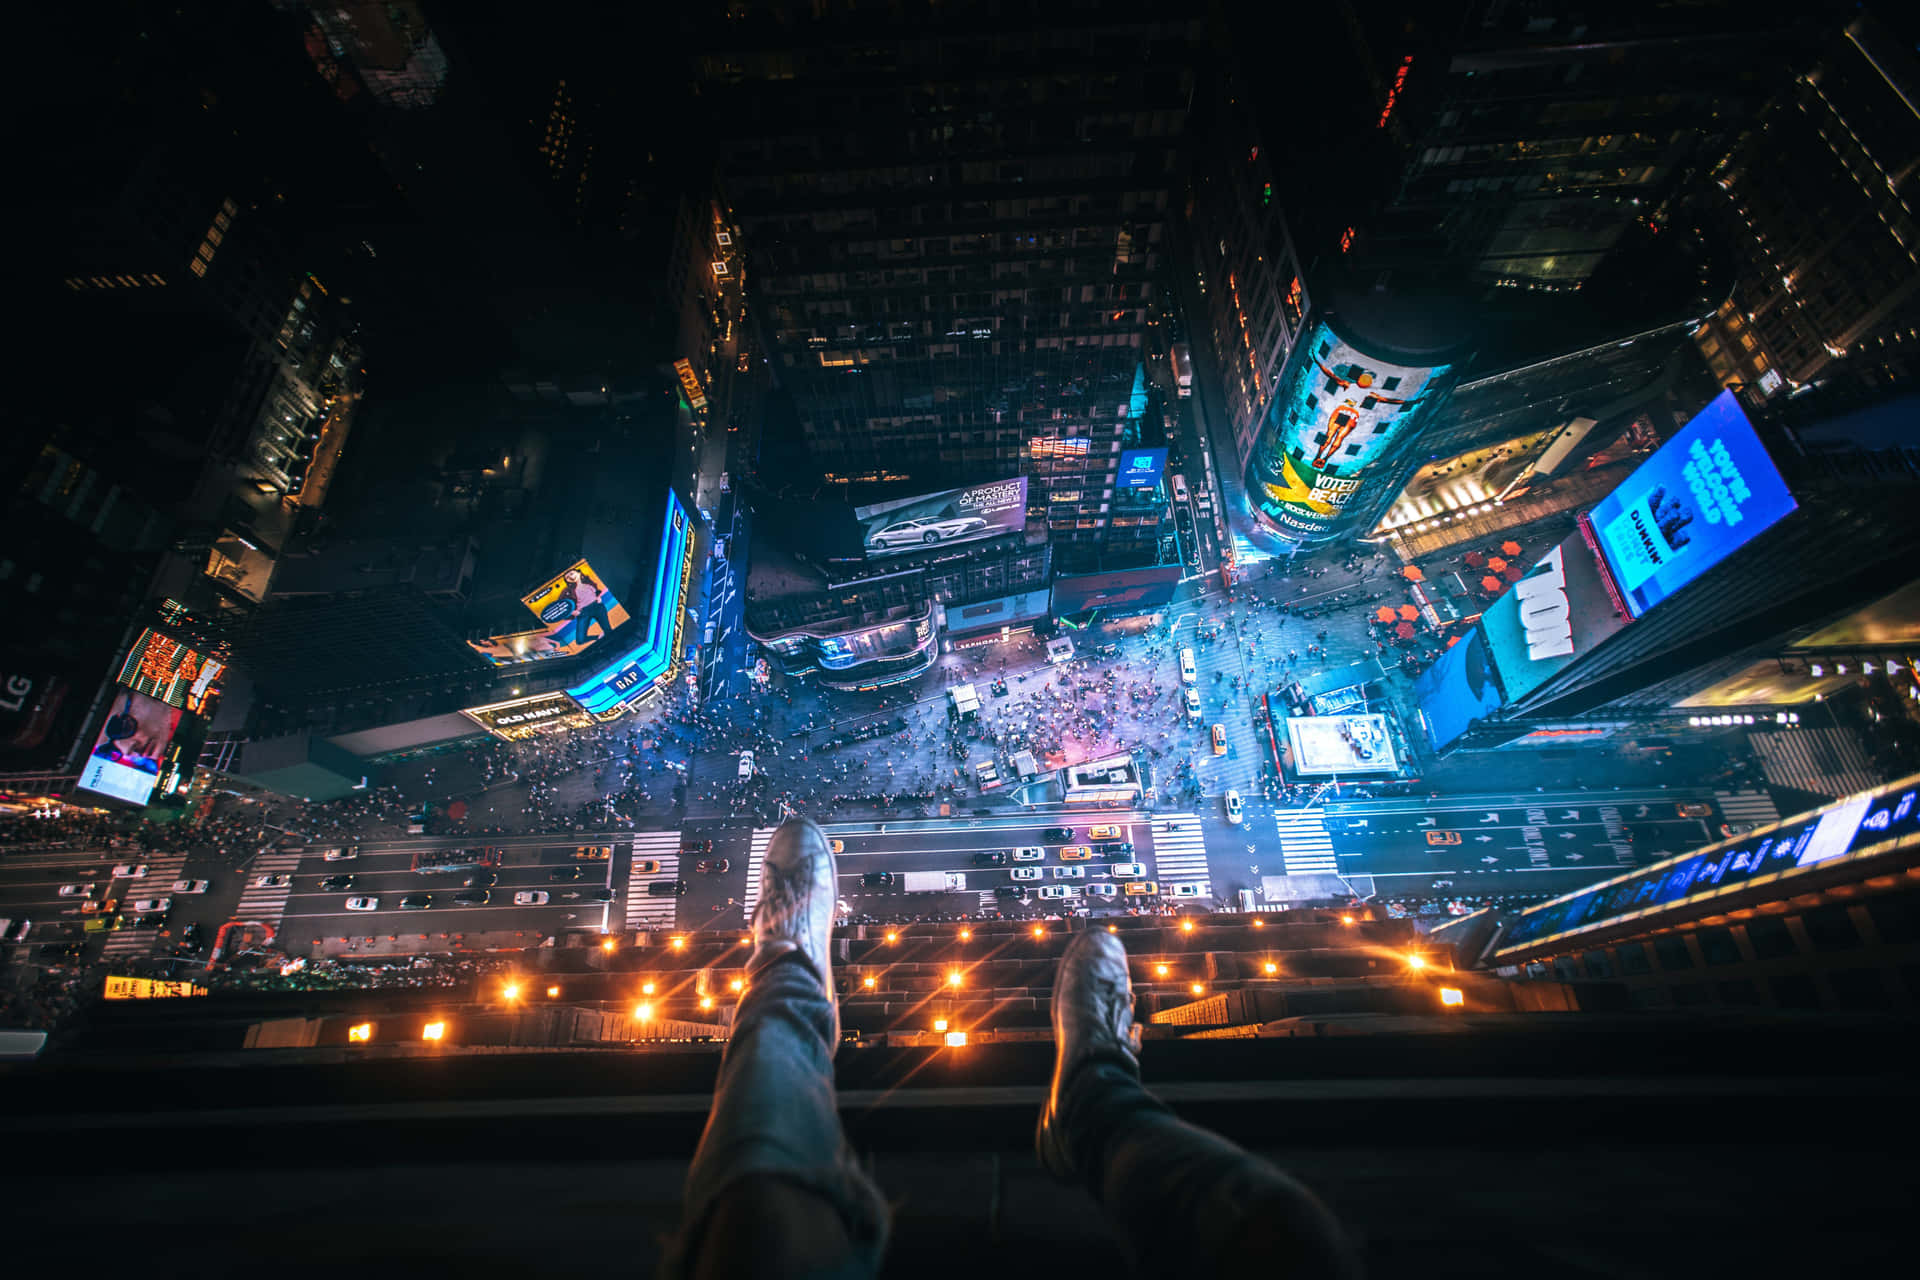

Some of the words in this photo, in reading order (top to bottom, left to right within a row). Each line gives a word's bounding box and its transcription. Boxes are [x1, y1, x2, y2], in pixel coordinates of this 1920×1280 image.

[1689, 438, 1743, 527] WELCOME
[1709, 438, 1751, 504] YOU'RE
[959, 497, 974, 505] OF
[975, 489, 1020, 502] MASTERY
[972, 482, 1020, 497] PRODUCT
[1682, 460, 1721, 524] WORLD
[1630, 509, 1664, 565] DUNKIN'
[960, 638, 999, 649] SEPHORA
[0, 674, 33, 712] LG
[615, 671, 639, 691] GAP
[497, 714, 525, 726] OLD
[524, 706, 561, 722] NAVY
